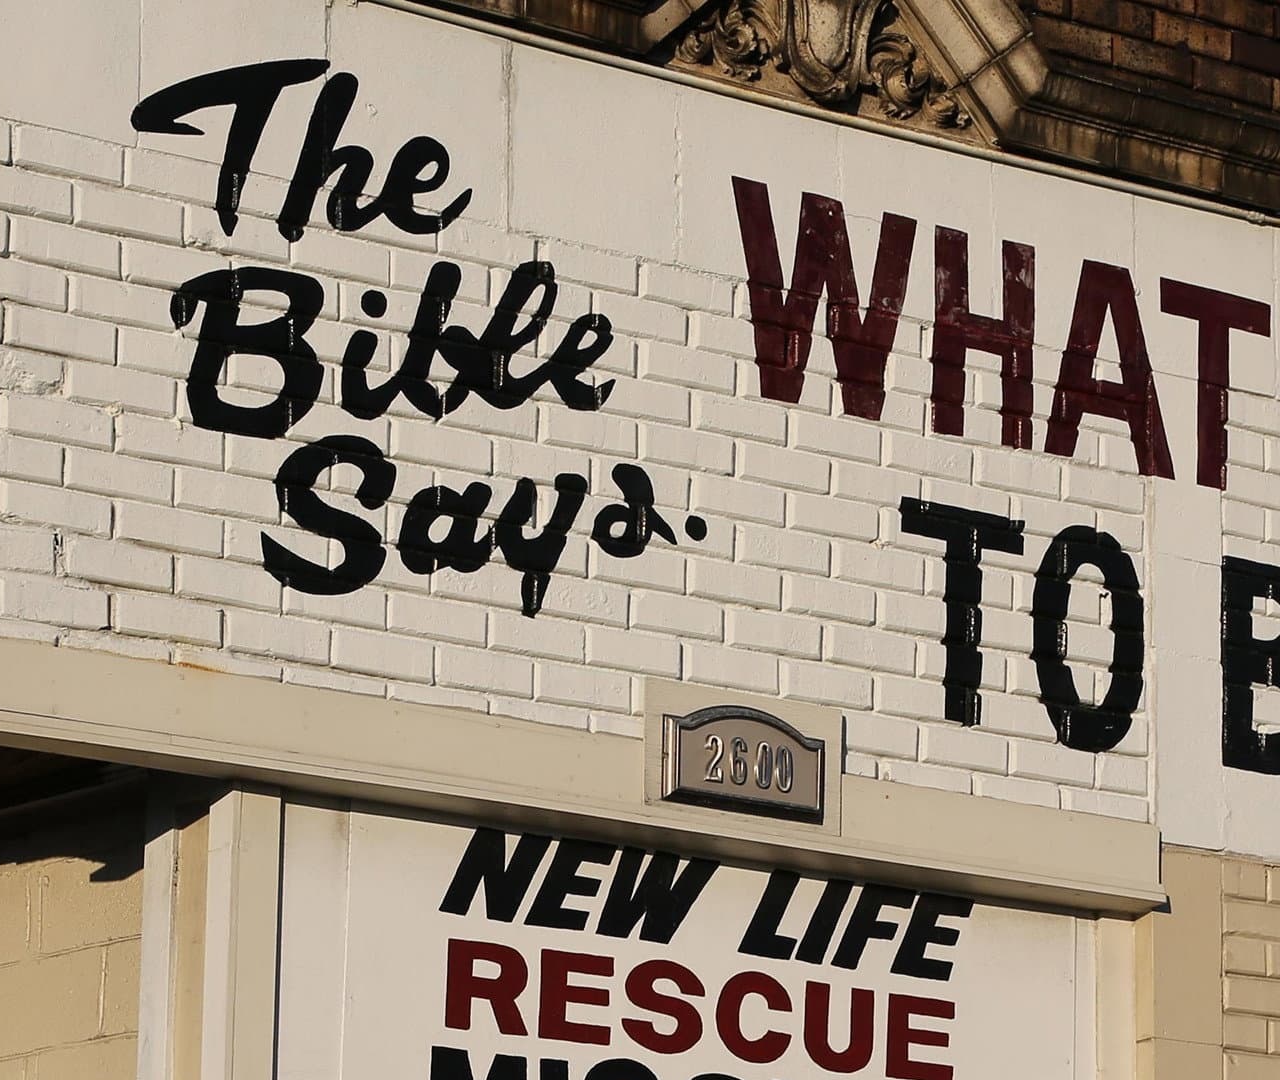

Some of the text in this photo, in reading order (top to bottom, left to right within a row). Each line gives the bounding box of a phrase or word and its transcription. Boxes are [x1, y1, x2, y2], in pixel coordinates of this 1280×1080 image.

[131, 58, 473, 243] The
[170, 260, 617, 440] Bible
[732, 175, 1271, 491] WHAT
[900, 496, 1146, 752] TO
[704, 734, 795, 793] 2600
[439, 827, 974, 982] NEW LIFE
